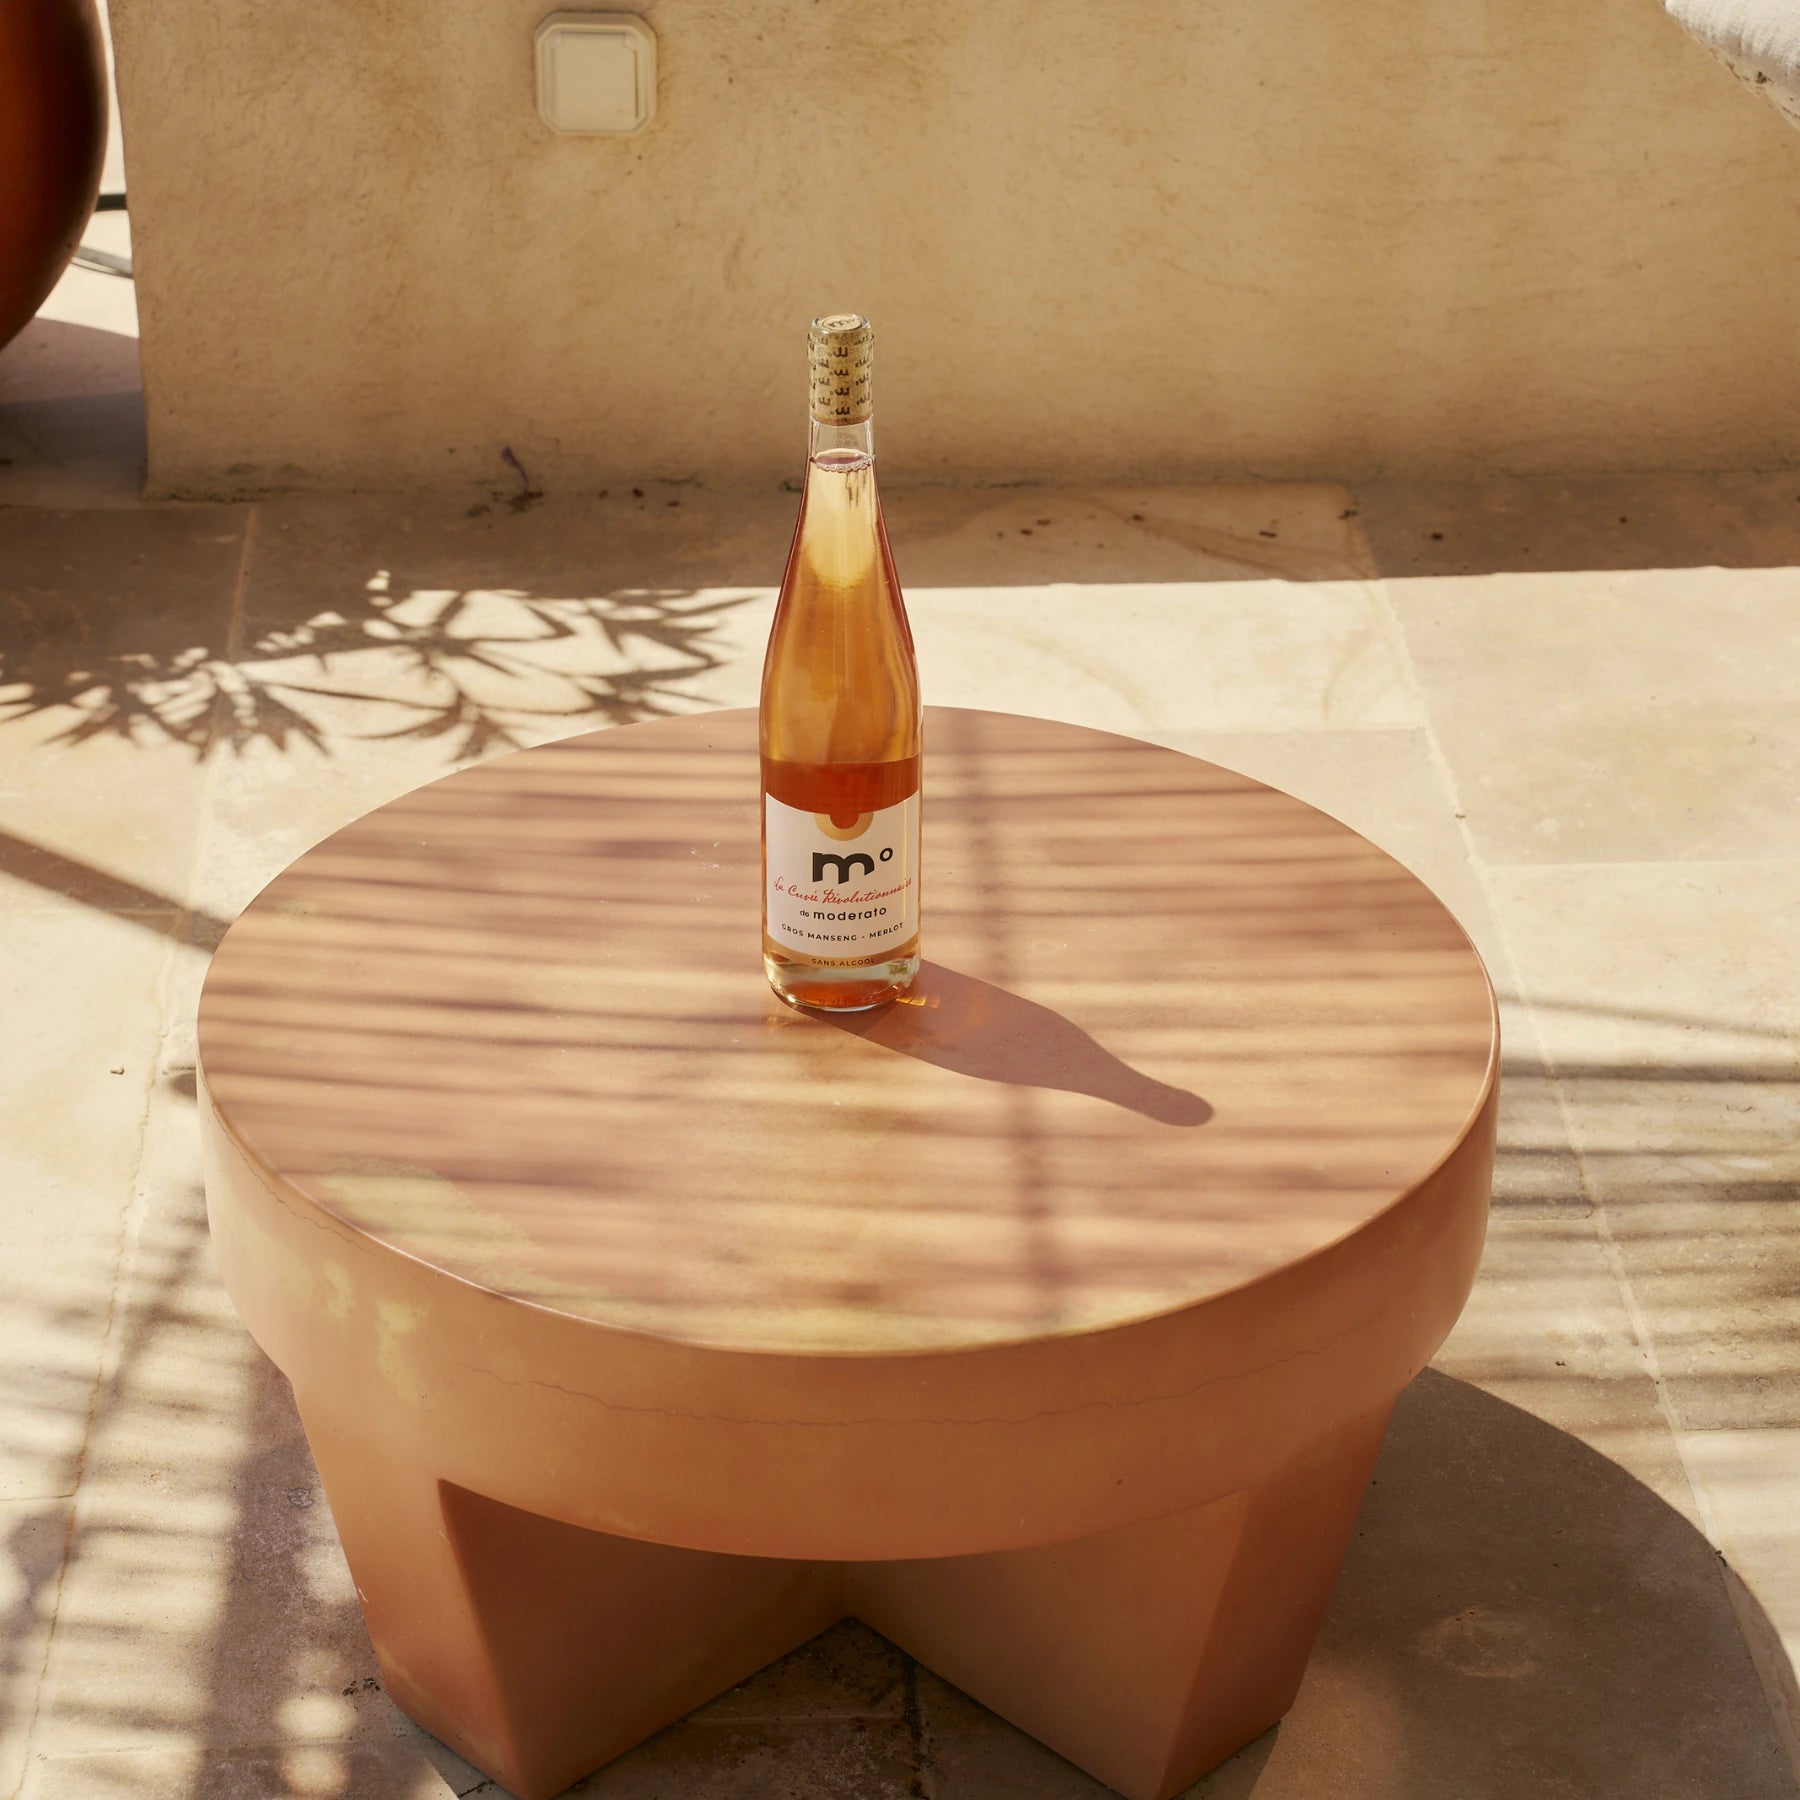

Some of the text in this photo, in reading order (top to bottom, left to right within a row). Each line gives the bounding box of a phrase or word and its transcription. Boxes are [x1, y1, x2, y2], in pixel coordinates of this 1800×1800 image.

[800, 907, 887, 921] de moderato
[781, 923, 804, 937] GROS
[807, 932, 857, 942] MANSENG
[869, 922, 904, 939] MERLOT
[811, 957, 875, 967] SANS ALCOOL
